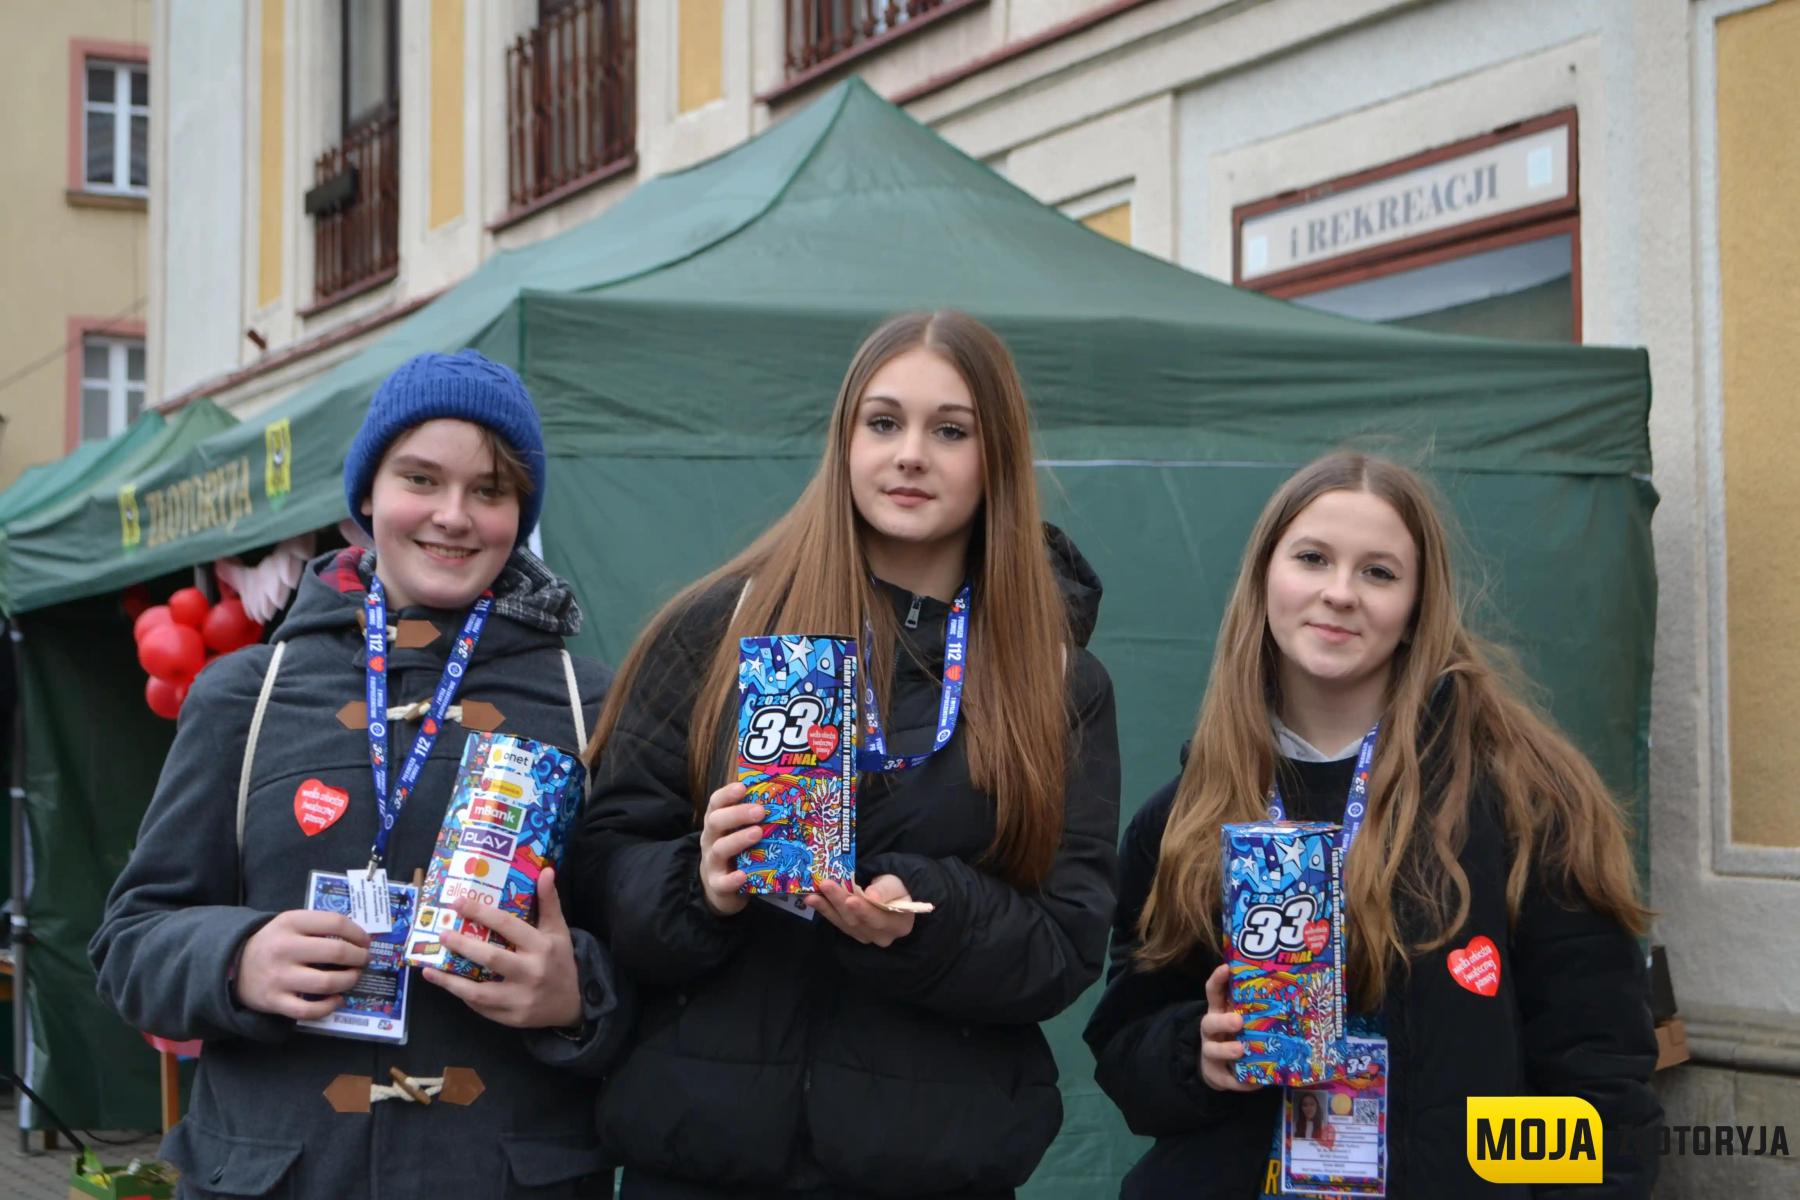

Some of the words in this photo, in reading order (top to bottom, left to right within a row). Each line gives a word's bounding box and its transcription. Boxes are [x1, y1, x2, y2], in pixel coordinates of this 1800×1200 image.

[1307, 163, 1499, 252] REKREACJI
[369, 633, 384, 652] 112
[947, 642, 962, 661] 112
[843, 659, 851, 686] GRAMY
[757, 695, 790, 705] 2025
[843, 688, 851, 705] DLA
[745, 698, 823, 761] 33
[843, 706, 851, 748] ONKOLOGII
[414, 737, 431, 757] 112
[503, 752, 529, 766] onet
[475, 805, 515, 823] mBank
[464, 831, 508, 850] PLAY
[1251, 894, 1284, 904] 2025
[1240, 896, 1315, 957] 33
[1347, 1056, 1371, 1073] 33
